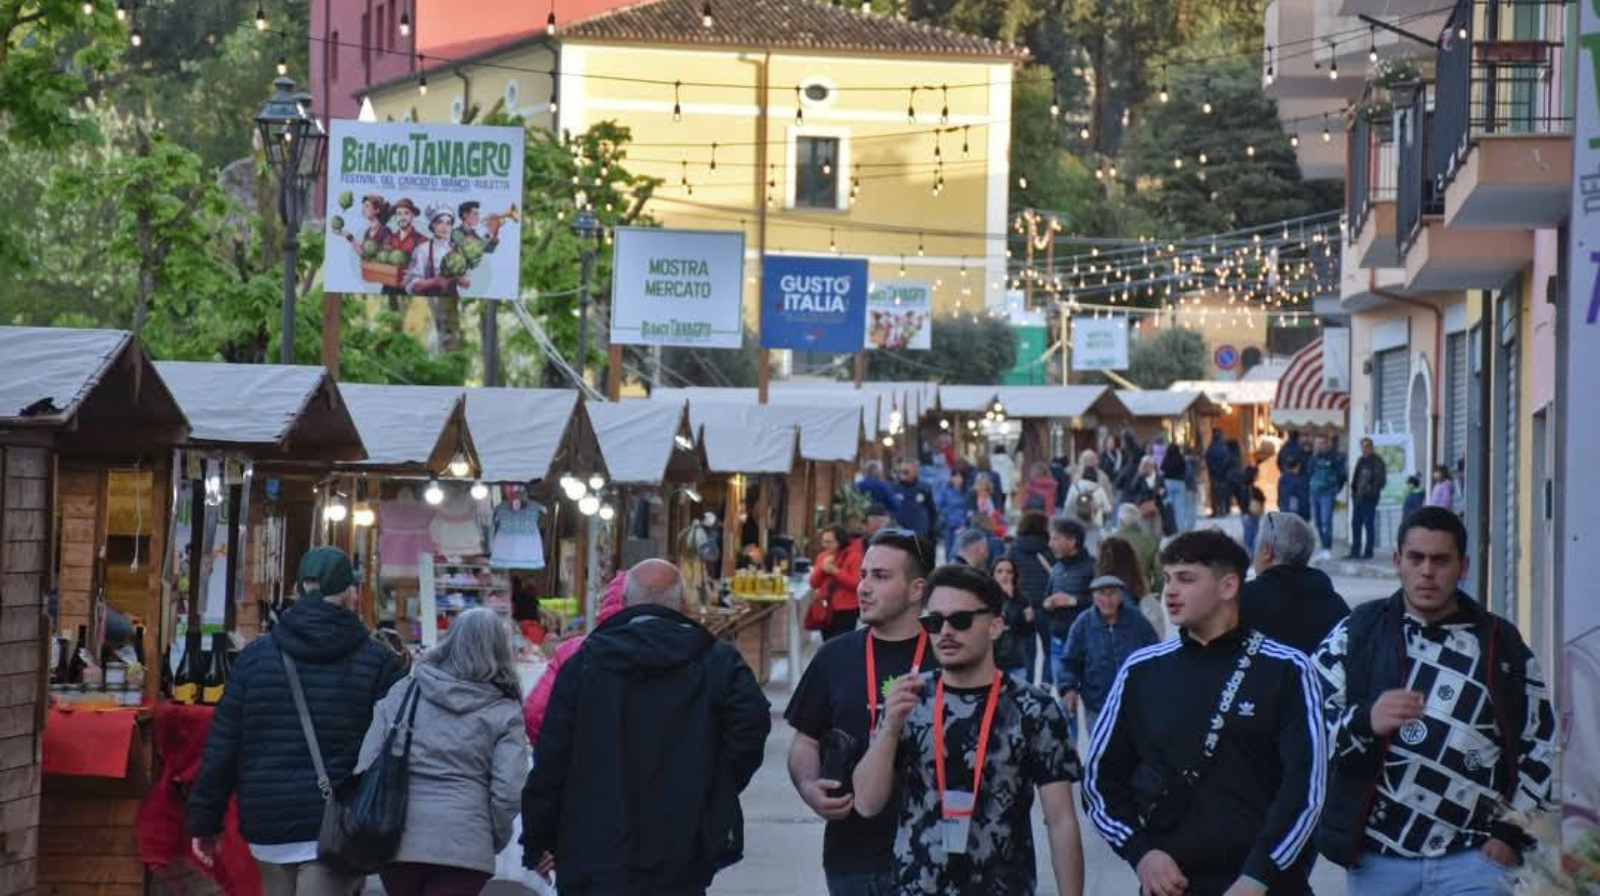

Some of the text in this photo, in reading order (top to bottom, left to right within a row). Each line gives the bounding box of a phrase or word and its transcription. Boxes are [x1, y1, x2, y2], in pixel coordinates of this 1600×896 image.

[648, 258, 709, 277] MOSTRA
[645, 279, 712, 299] MERCATO
[780, 274, 851, 295] GUSTO
[784, 292, 846, 314] ITALIA
[1220, 670, 1245, 712] adidas
